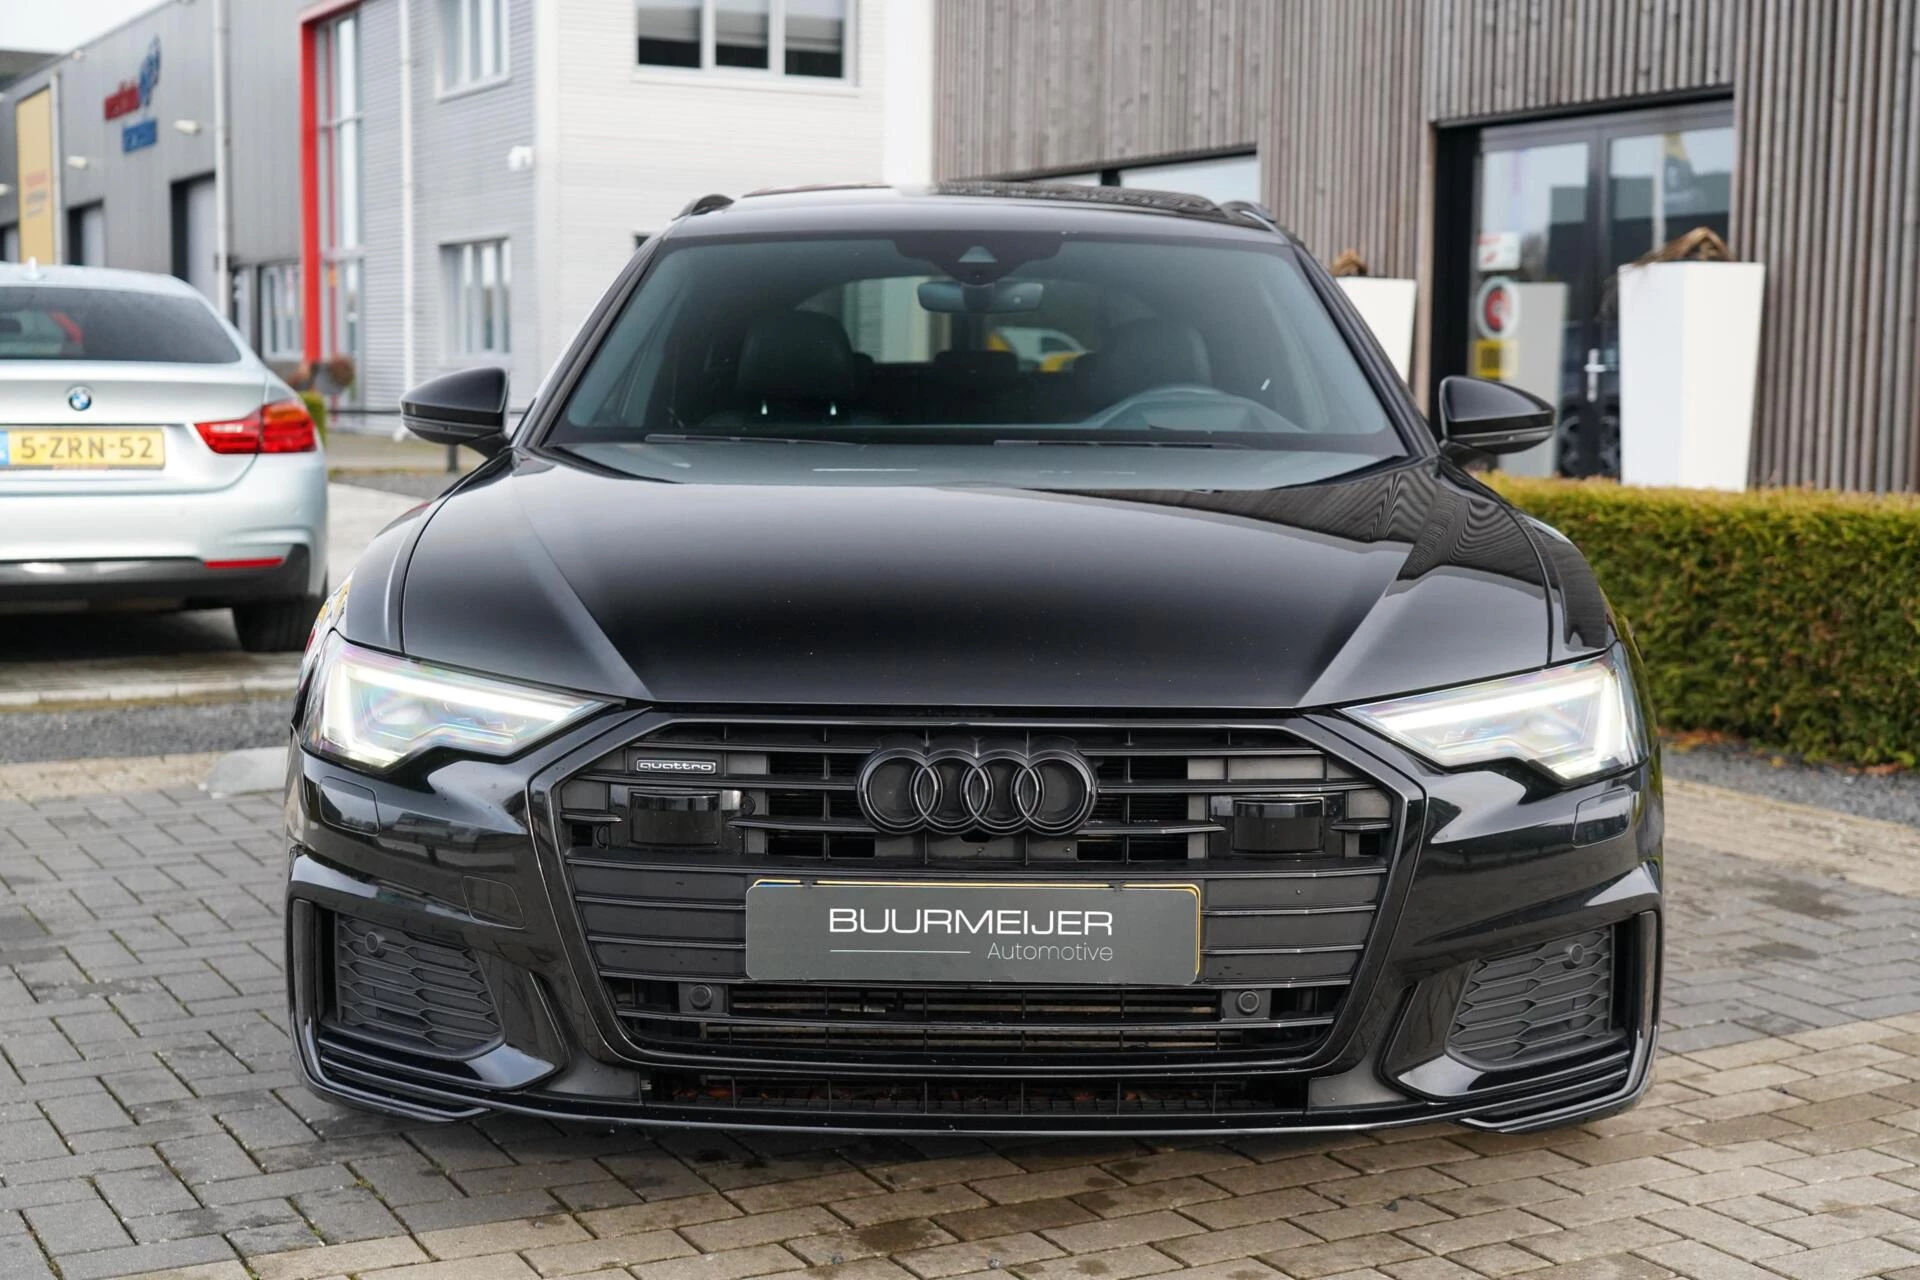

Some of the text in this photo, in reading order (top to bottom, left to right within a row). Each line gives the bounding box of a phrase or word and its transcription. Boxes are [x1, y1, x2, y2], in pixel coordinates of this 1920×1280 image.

[20, 436, 153, 459] 5-ZRN-52
[640, 762, 712, 771] quattro
[829, 908, 1113, 936] BUURMEIJER
[987, 942, 1113, 962] Automotive
